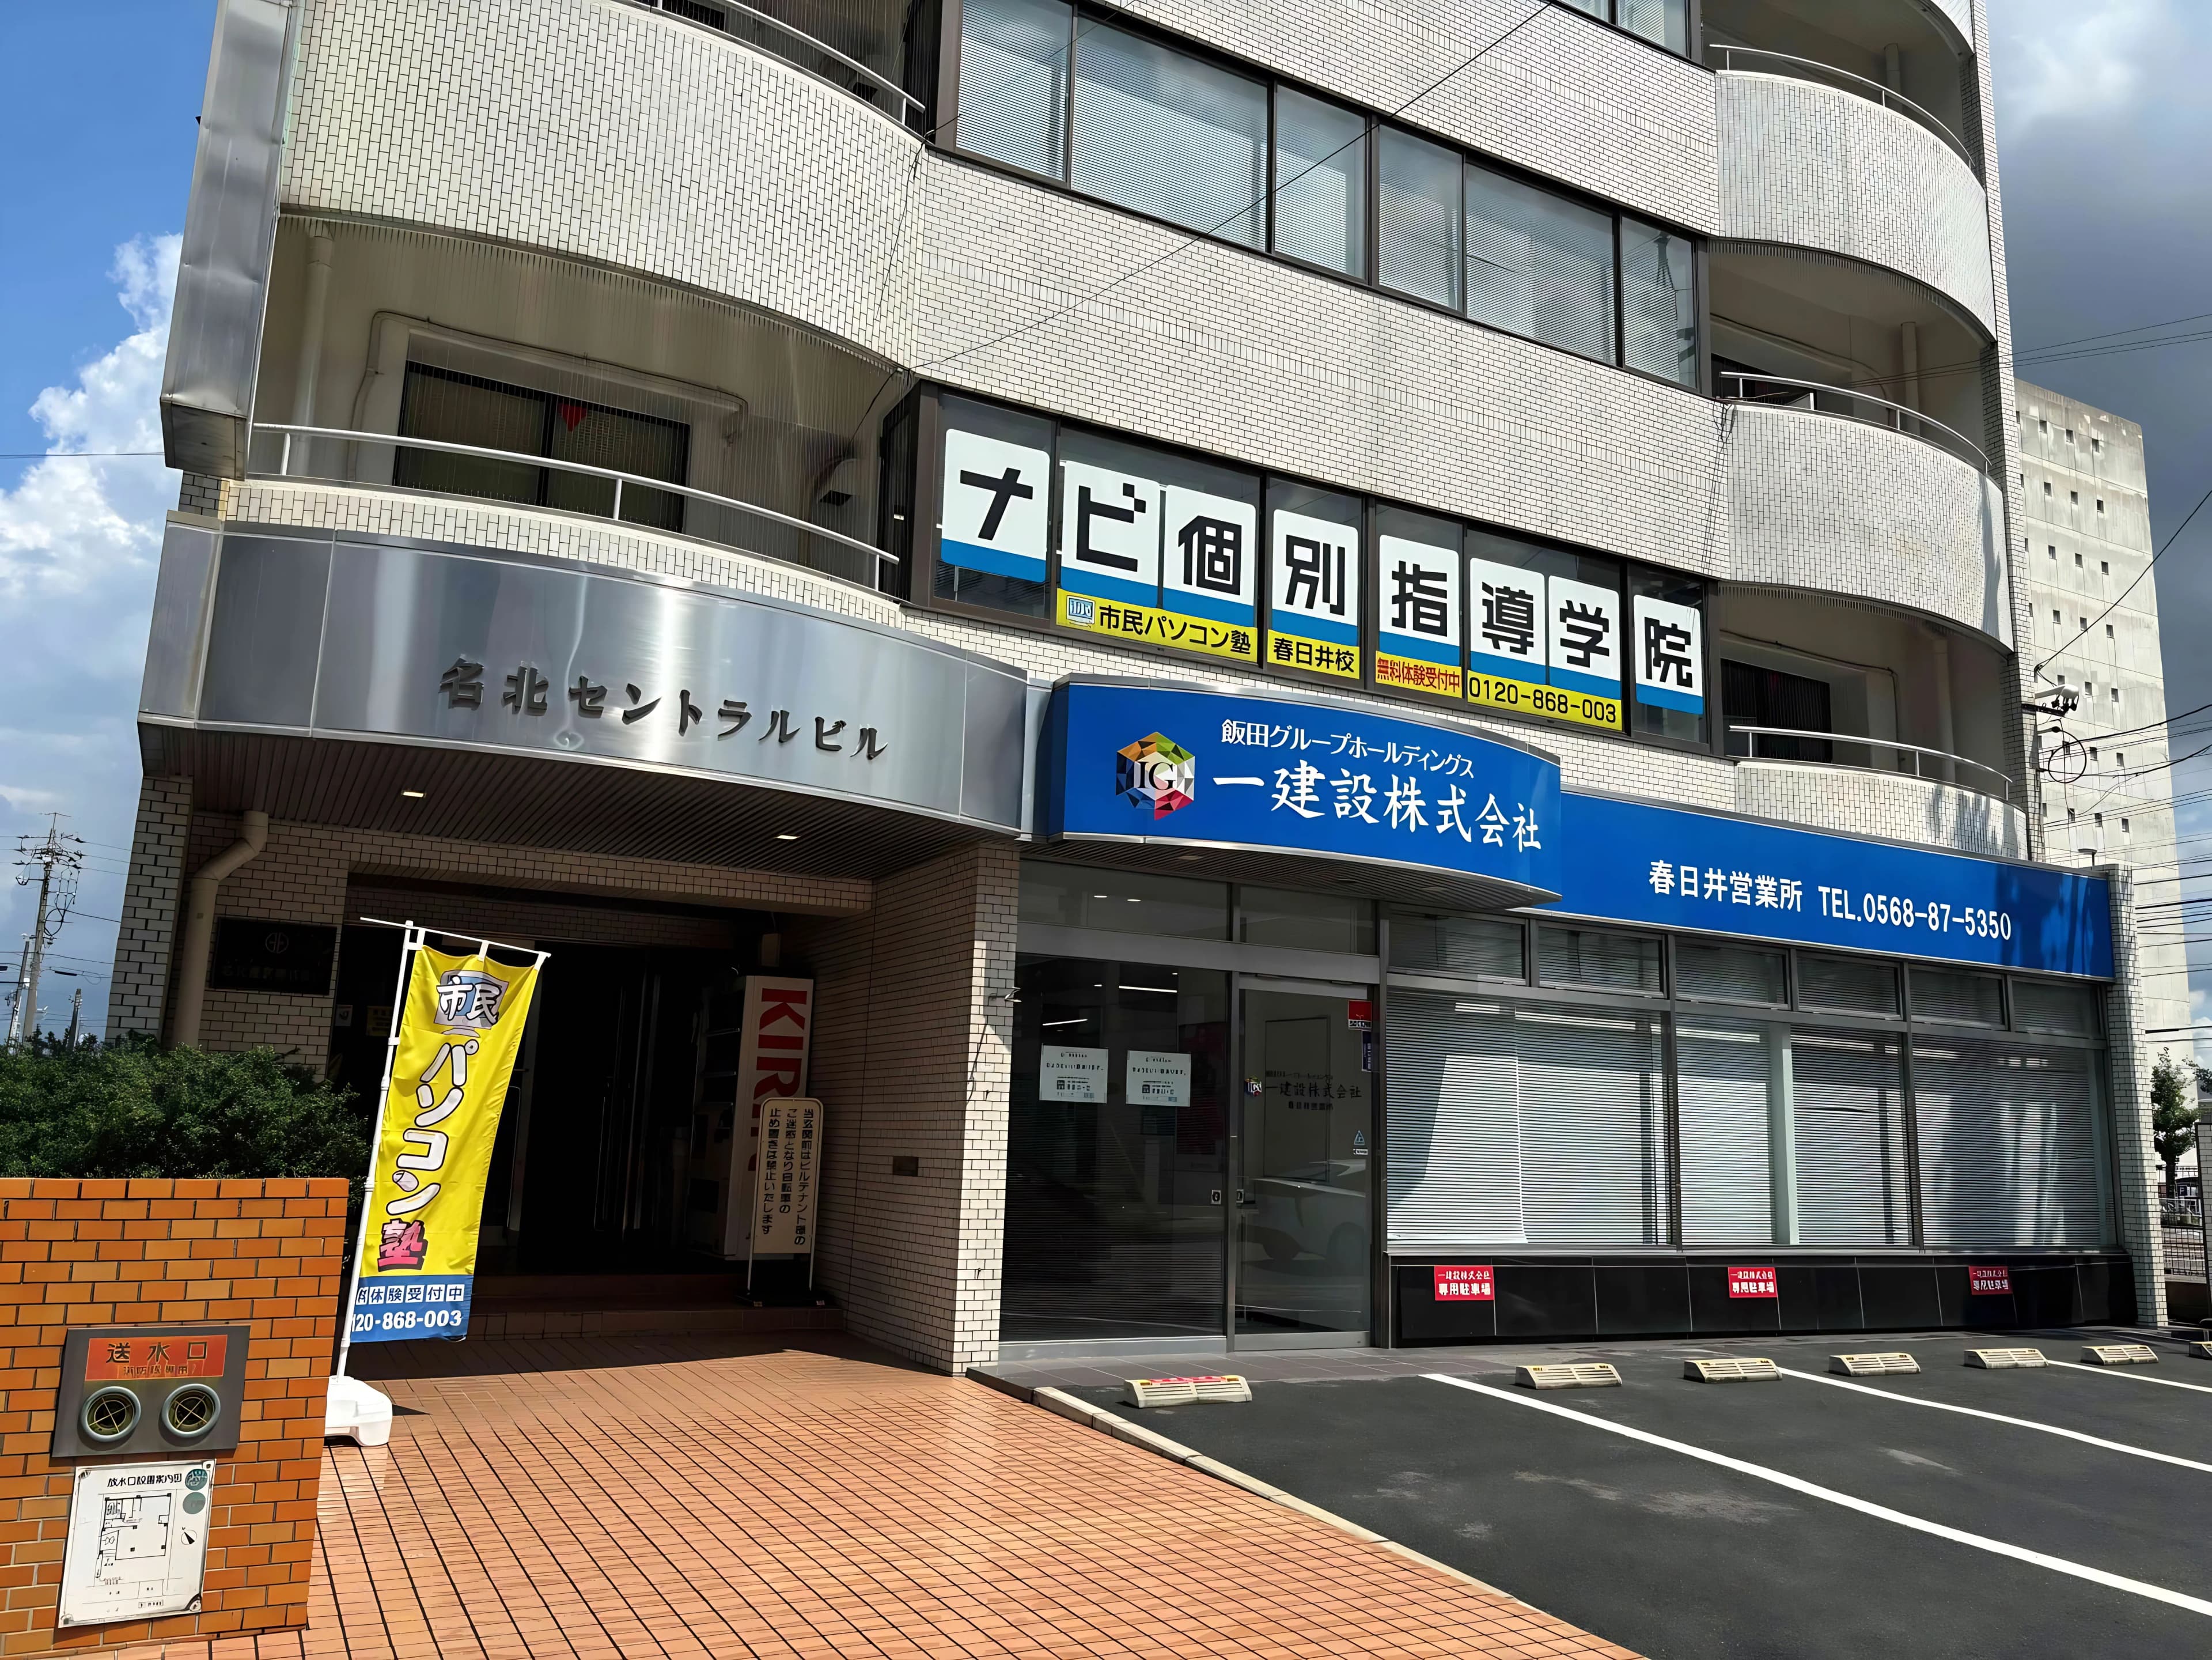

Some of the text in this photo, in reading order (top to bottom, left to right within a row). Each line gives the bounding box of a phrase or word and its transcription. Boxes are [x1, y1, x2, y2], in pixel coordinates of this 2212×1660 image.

[960, 467, 1693, 689] ナビ個別指導学院
[1099, 605, 1252, 655] 市民パソコン塾
[1273, 637, 1354, 673] 春日井校
[1377, 657, 1460, 693] 無料体験受付中
[1468, 676, 1617, 723] 0120-868-003
[439, 656, 889, 761] 名北セントラルビル
[1221, 718, 1475, 779] 飯田グループホールディングス
[1136, 761, 1176, 791] IG
[1213, 759, 1543, 853] 一建設株式会社
[1648, 859, 2012, 941] 春日井営業所 TEL.0568-87-5350
[435, 975, 503, 1024] 市民
[378, 1039, 479, 1272] パソコン塾
[105, 1341, 209, 1364] 送水口
